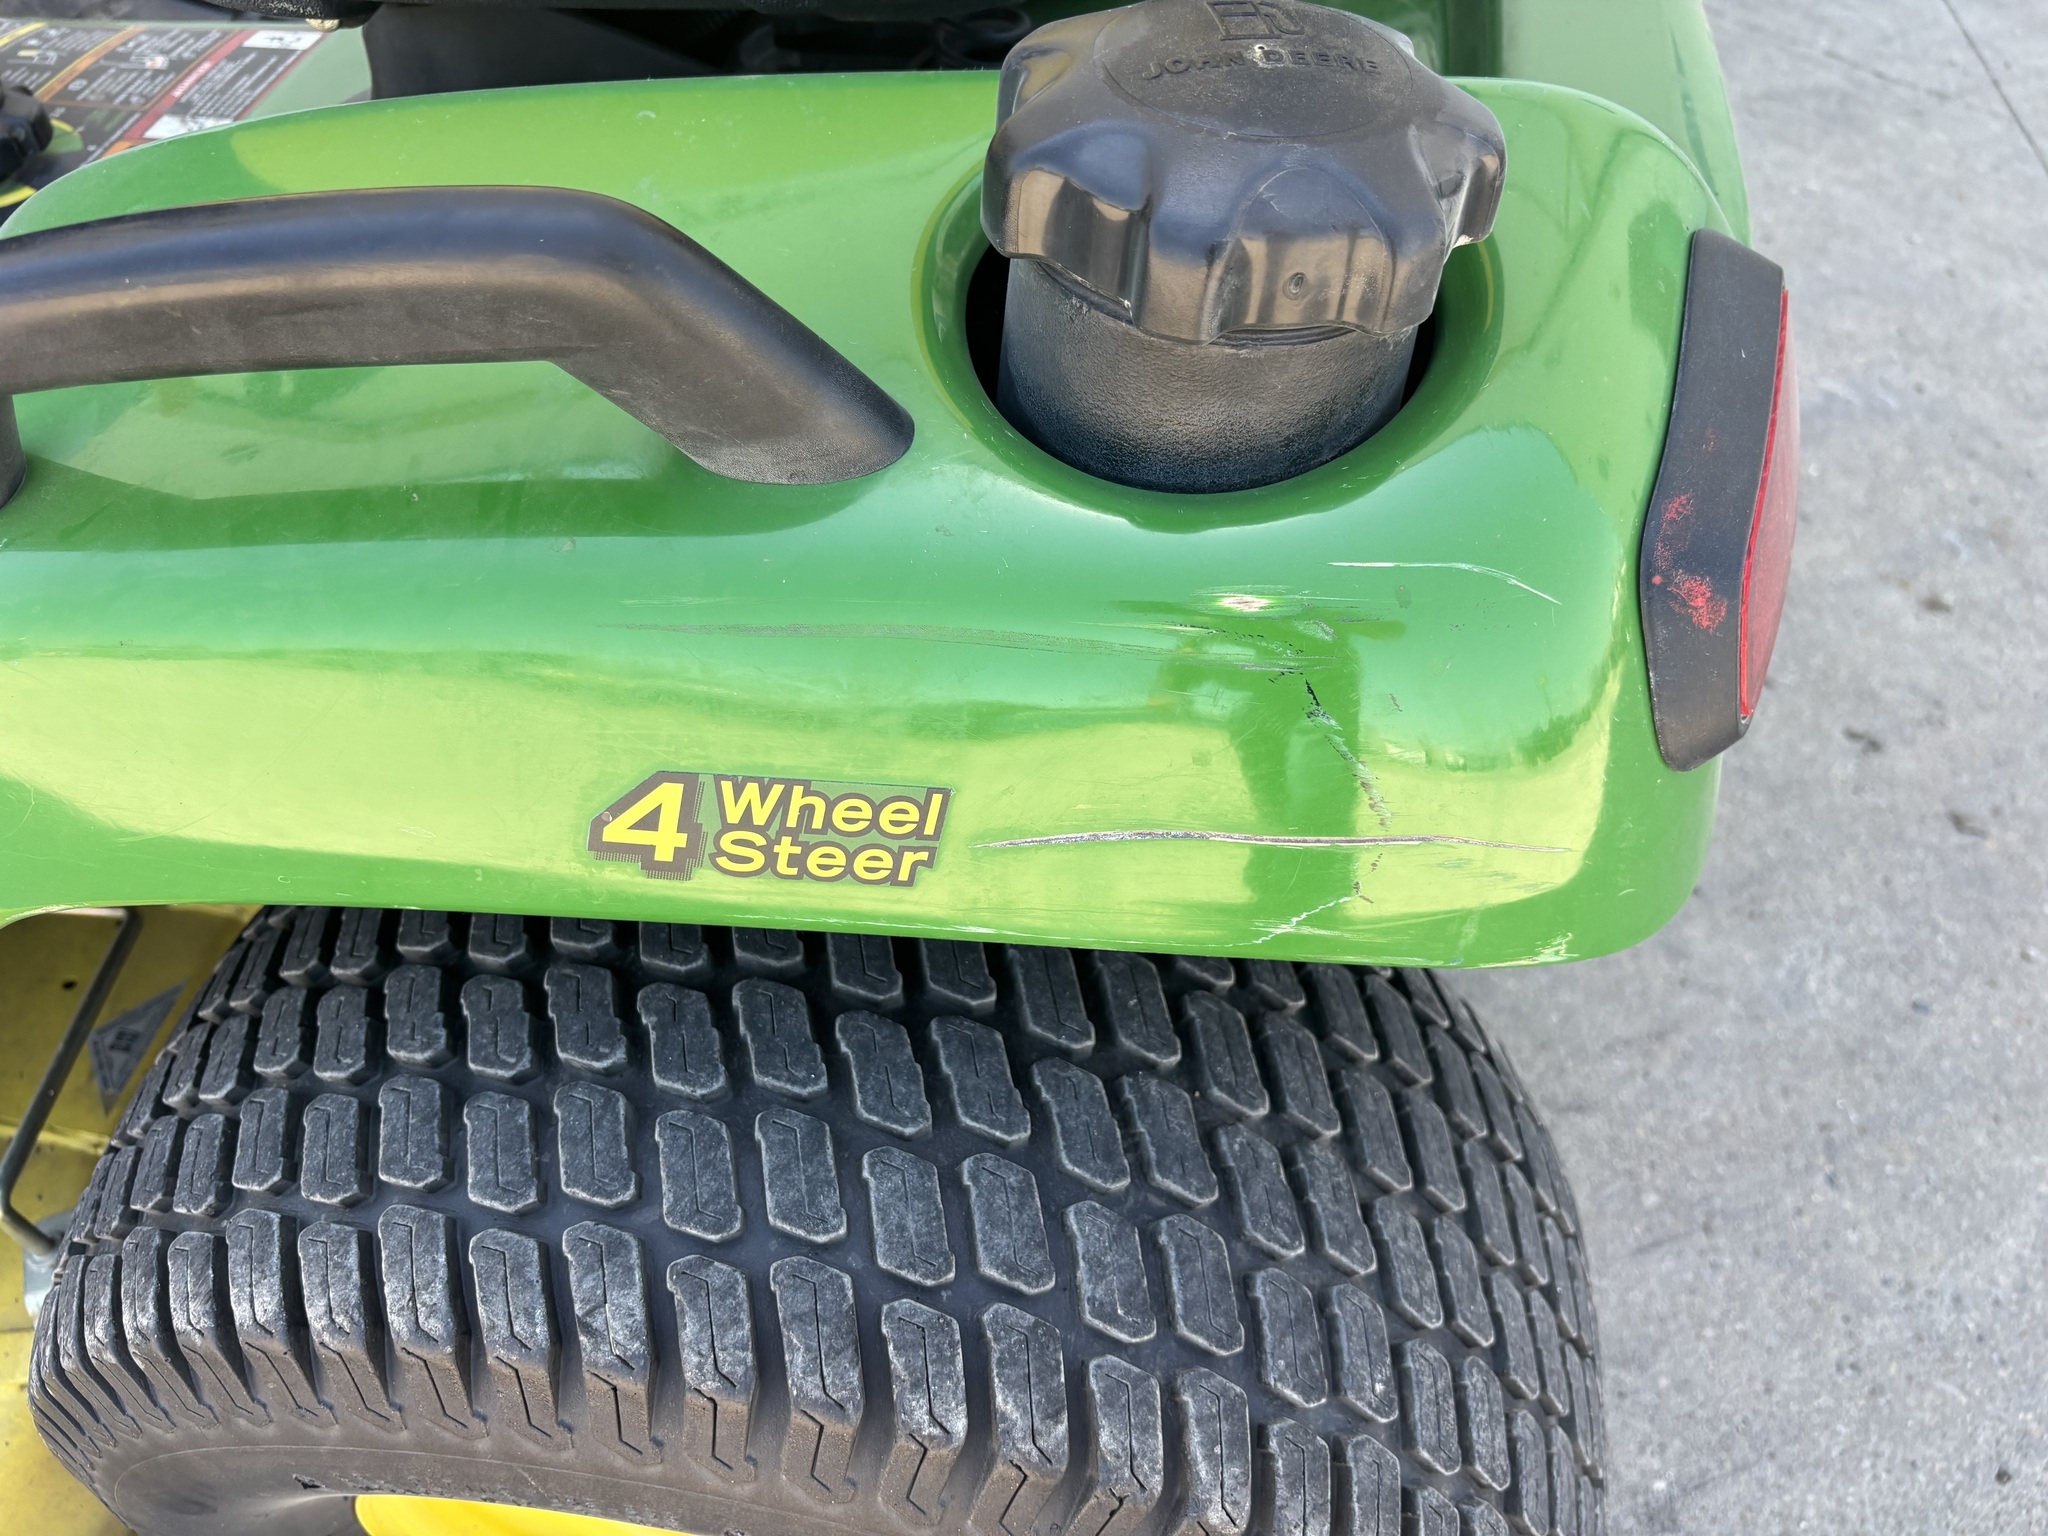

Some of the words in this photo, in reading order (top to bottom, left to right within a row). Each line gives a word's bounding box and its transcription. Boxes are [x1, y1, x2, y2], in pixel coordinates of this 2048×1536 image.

[1141, 51, 1246, 80] JOHN
[1262, 49, 1382, 74] DEERE
[602, 782, 688, 862] 4
[721, 780, 943, 836] Wheel
[715, 830, 929, 882] Steer
